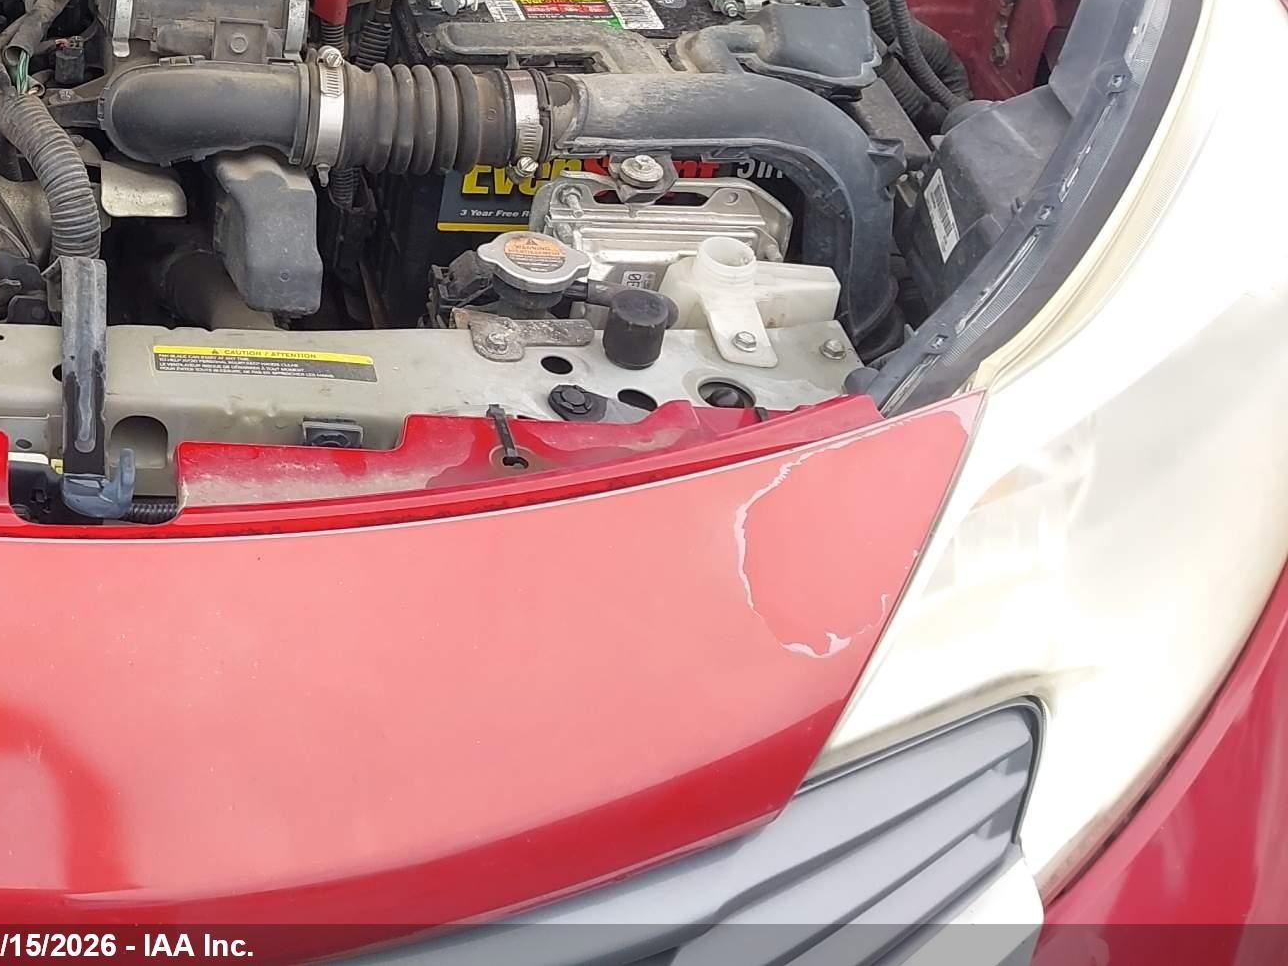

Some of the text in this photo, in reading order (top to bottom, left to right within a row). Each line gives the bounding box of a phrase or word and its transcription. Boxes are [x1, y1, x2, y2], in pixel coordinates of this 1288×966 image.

[459, 209, 468, 217] 3
[470, 209, 494, 217] Year
[495, 209, 519, 218] Free
